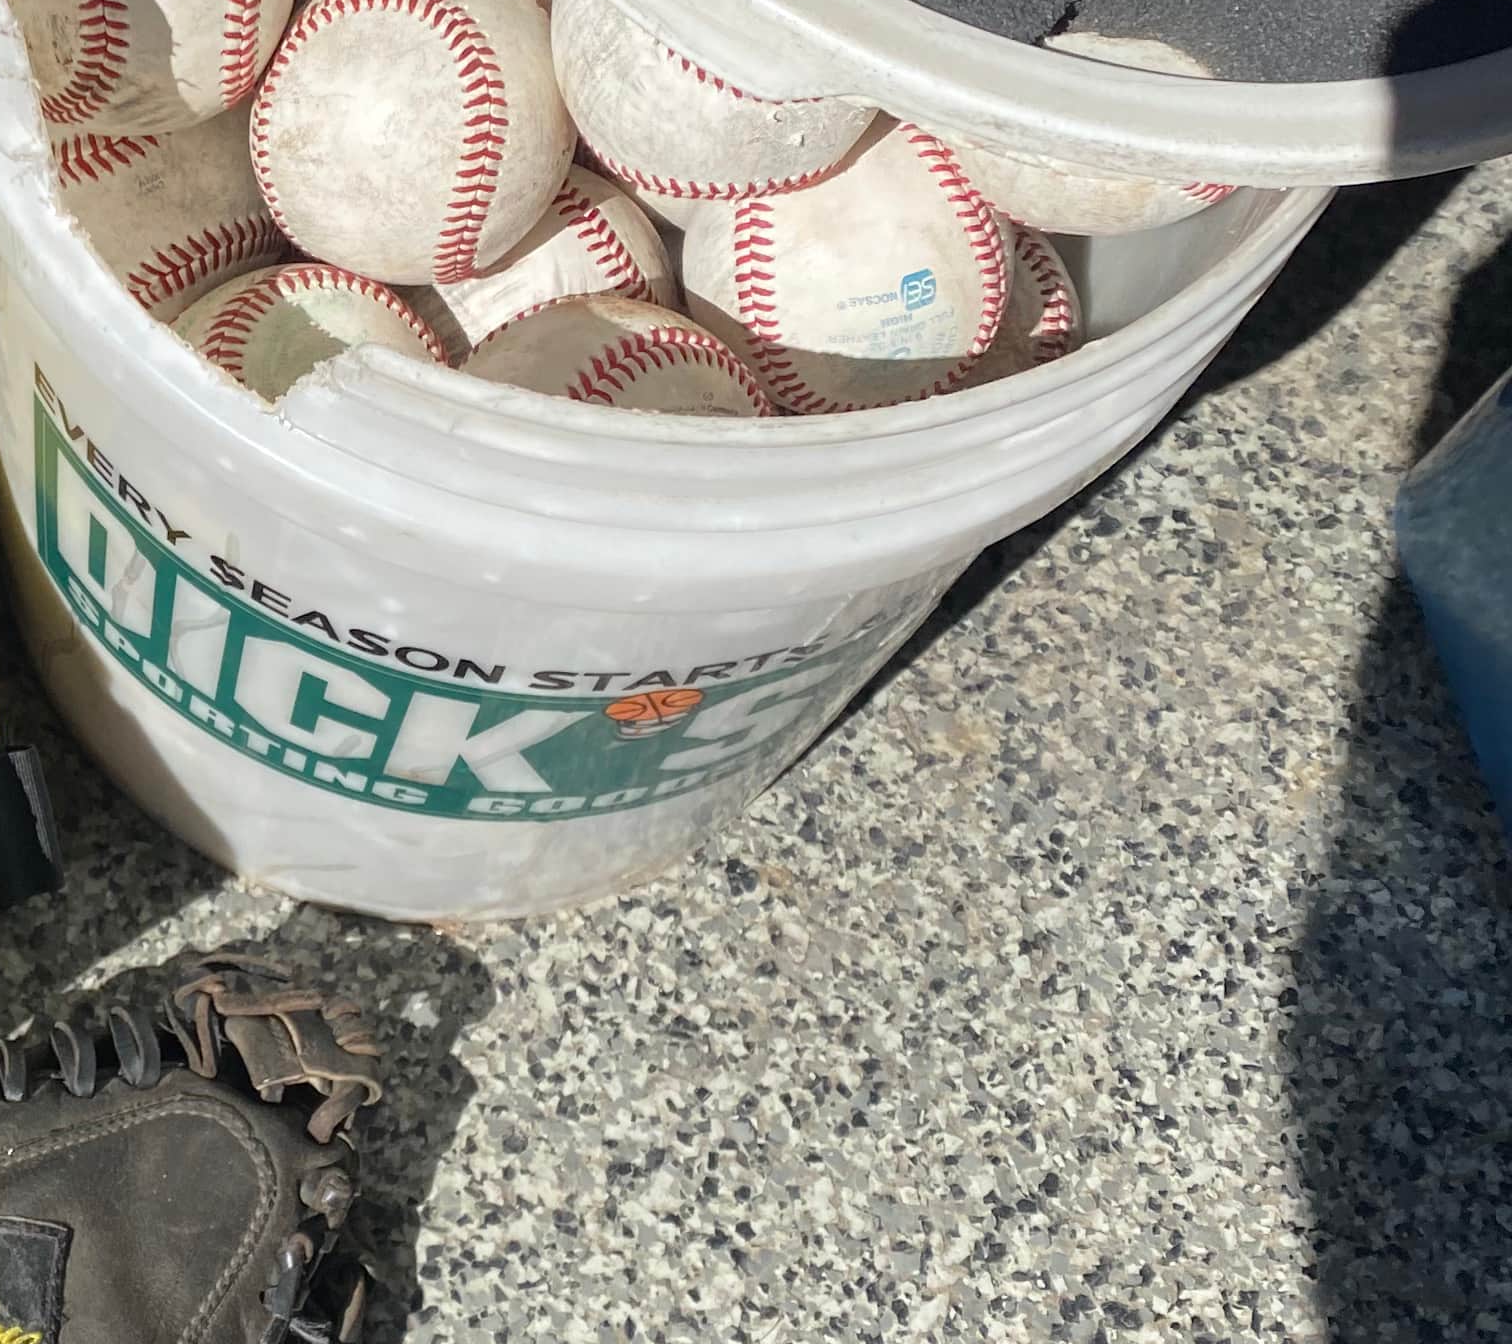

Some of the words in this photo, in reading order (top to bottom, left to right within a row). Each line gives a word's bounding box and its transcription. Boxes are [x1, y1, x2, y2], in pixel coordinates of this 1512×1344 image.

[34, 362, 193, 546] EVERY
[209, 554, 506, 684] SEASON
[529, 635, 829, 692] STARTS
[67, 575, 429, 806] SPORTING
